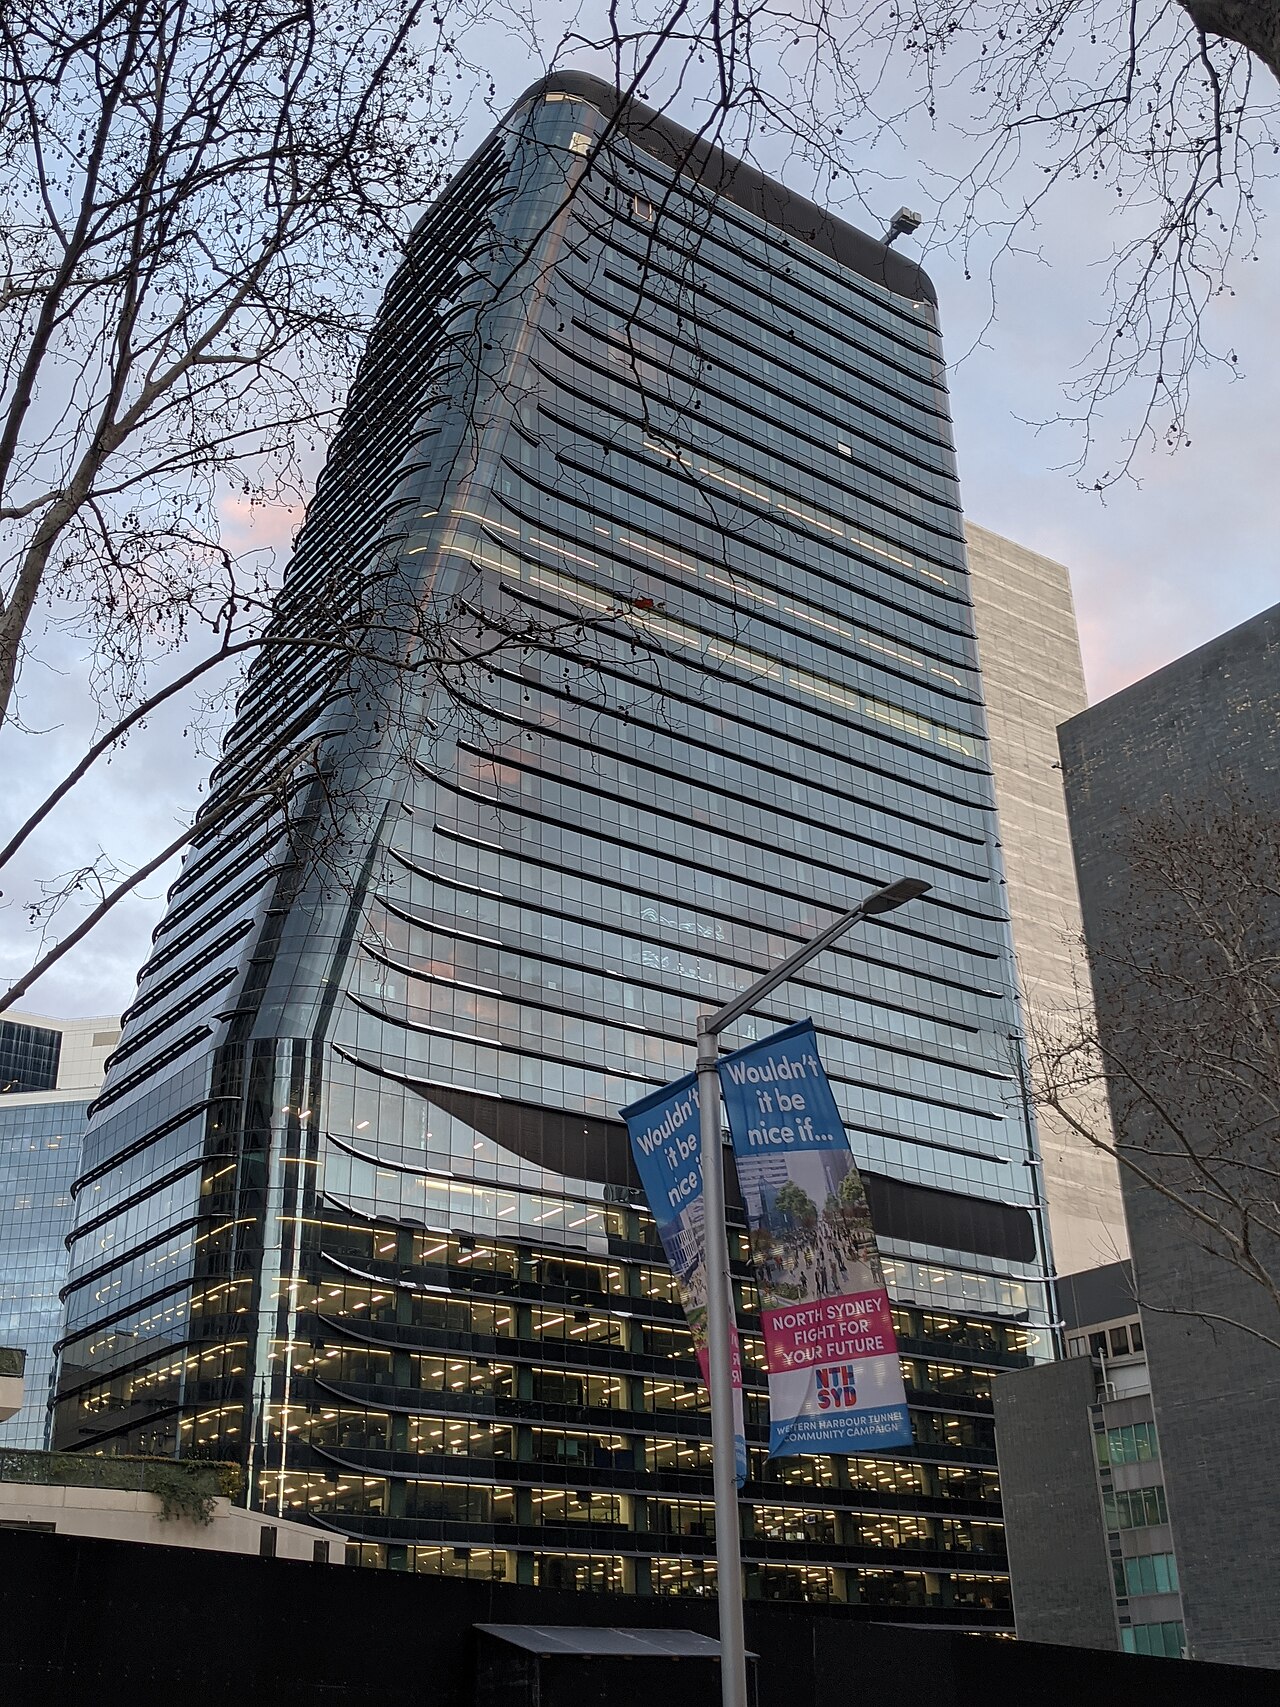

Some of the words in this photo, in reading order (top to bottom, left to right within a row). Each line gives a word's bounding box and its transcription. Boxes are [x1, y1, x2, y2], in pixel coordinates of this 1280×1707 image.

[725, 1053, 819, 1085] Wouldn't
[755, 1089, 773, 1114] it
[774, 1087, 806, 1112] be
[636, 1087, 700, 1156] Wouldn't
[747, 1120, 795, 1146] nice
[795, 1116, 834, 1142] if...
[664, 1146, 679, 1171] it
[675, 1133, 697, 1160] be
[668, 1171, 698, 1208] nice
[772, 1308, 823, 1331] NORTH
[826, 1297, 882, 1320] SYDNEY
[794, 1324, 836, 1346] FIGHT
[839, 1319, 870, 1337] FOR
[782, 1345, 823, 1365] YOUR
[827, 1335, 885, 1357] FUTURE
[815, 1364, 856, 1390] NTH
[817, 1385, 858, 1410] SYD
[819, 1416, 867, 1430] HARBOUR
[867, 1411, 904, 1424] TUNNEL
[846, 1423, 899, 1437] CAMPAIGN
